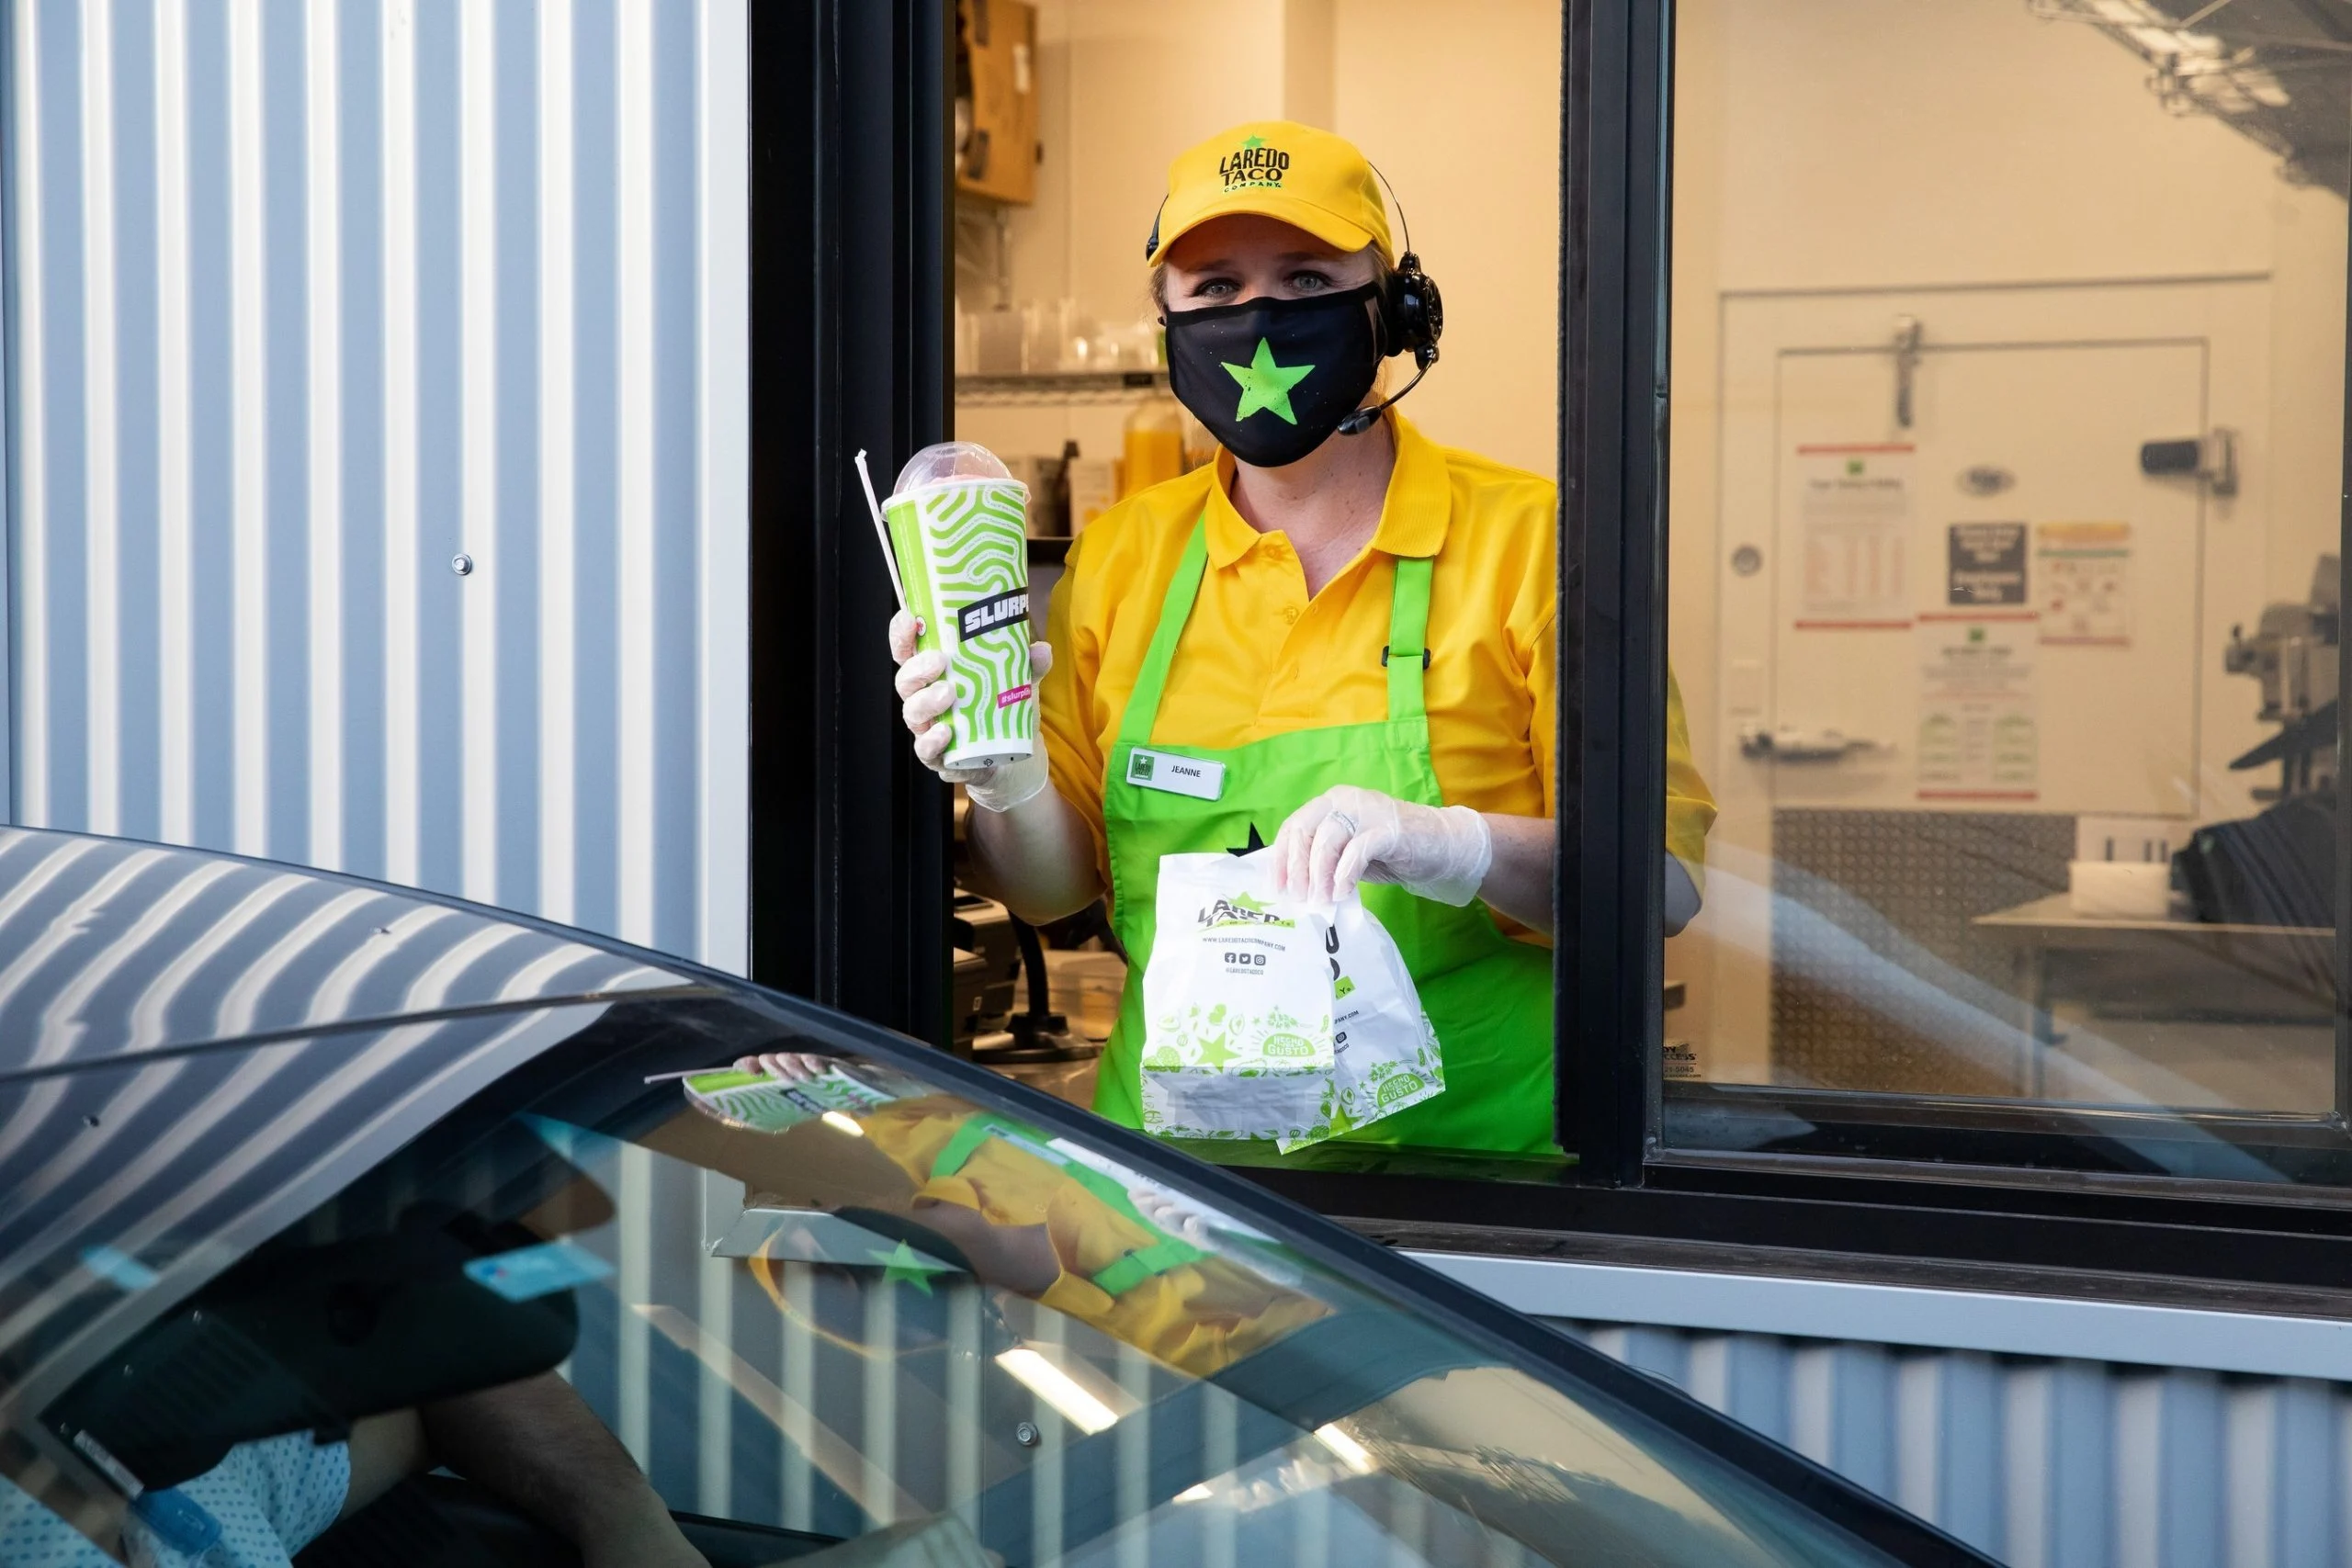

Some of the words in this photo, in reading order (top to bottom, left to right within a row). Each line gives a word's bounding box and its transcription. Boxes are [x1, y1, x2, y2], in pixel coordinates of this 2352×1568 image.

[1219, 147, 1290, 175] LAREDO
[1221, 168, 1283, 186] TACO
[1224, 181, 1282, 193] COMPANY
[1171, 765, 1202, 778] JEANNE
[1267, 1043, 1309, 1056] GUSTO
[1380, 1080, 1419, 1103] GUSTO
